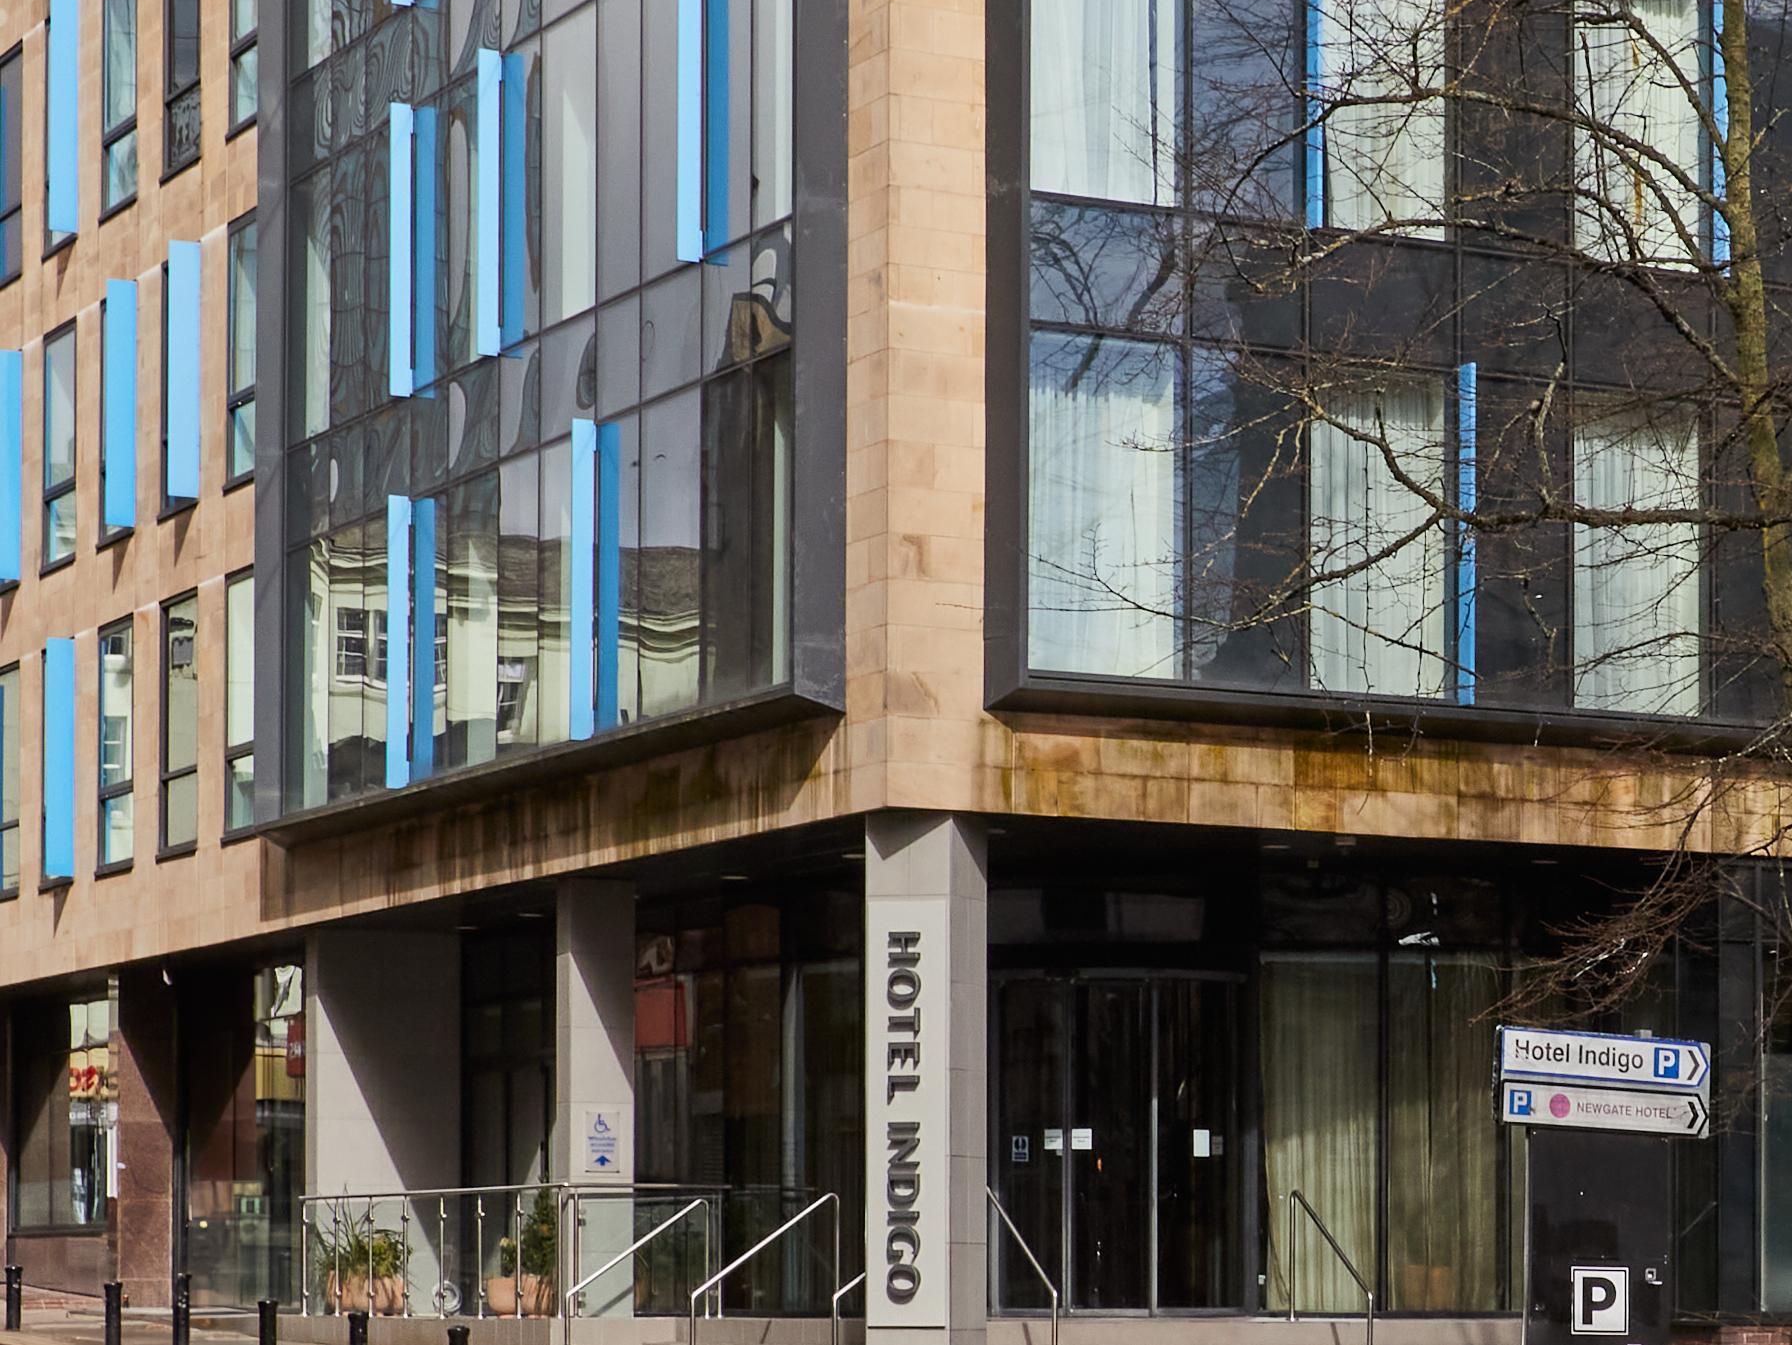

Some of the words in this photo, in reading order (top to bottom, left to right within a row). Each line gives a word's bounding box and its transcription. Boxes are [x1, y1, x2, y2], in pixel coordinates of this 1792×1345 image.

[887, 931, 921, 1105] HOTEL
[1515, 1038, 1570, 1064] Hotel
[1578, 1044, 1644, 1073] Indigo
[1658, 1050, 1676, 1076] P
[1513, 1091, 1528, 1114] P
[1576, 1102, 1632, 1117] NEWGATE
[1635, 1106, 1673, 1120] HOTEL
[886, 1121, 921, 1305] INDIGO
[1581, 1276, 1617, 1325] P
